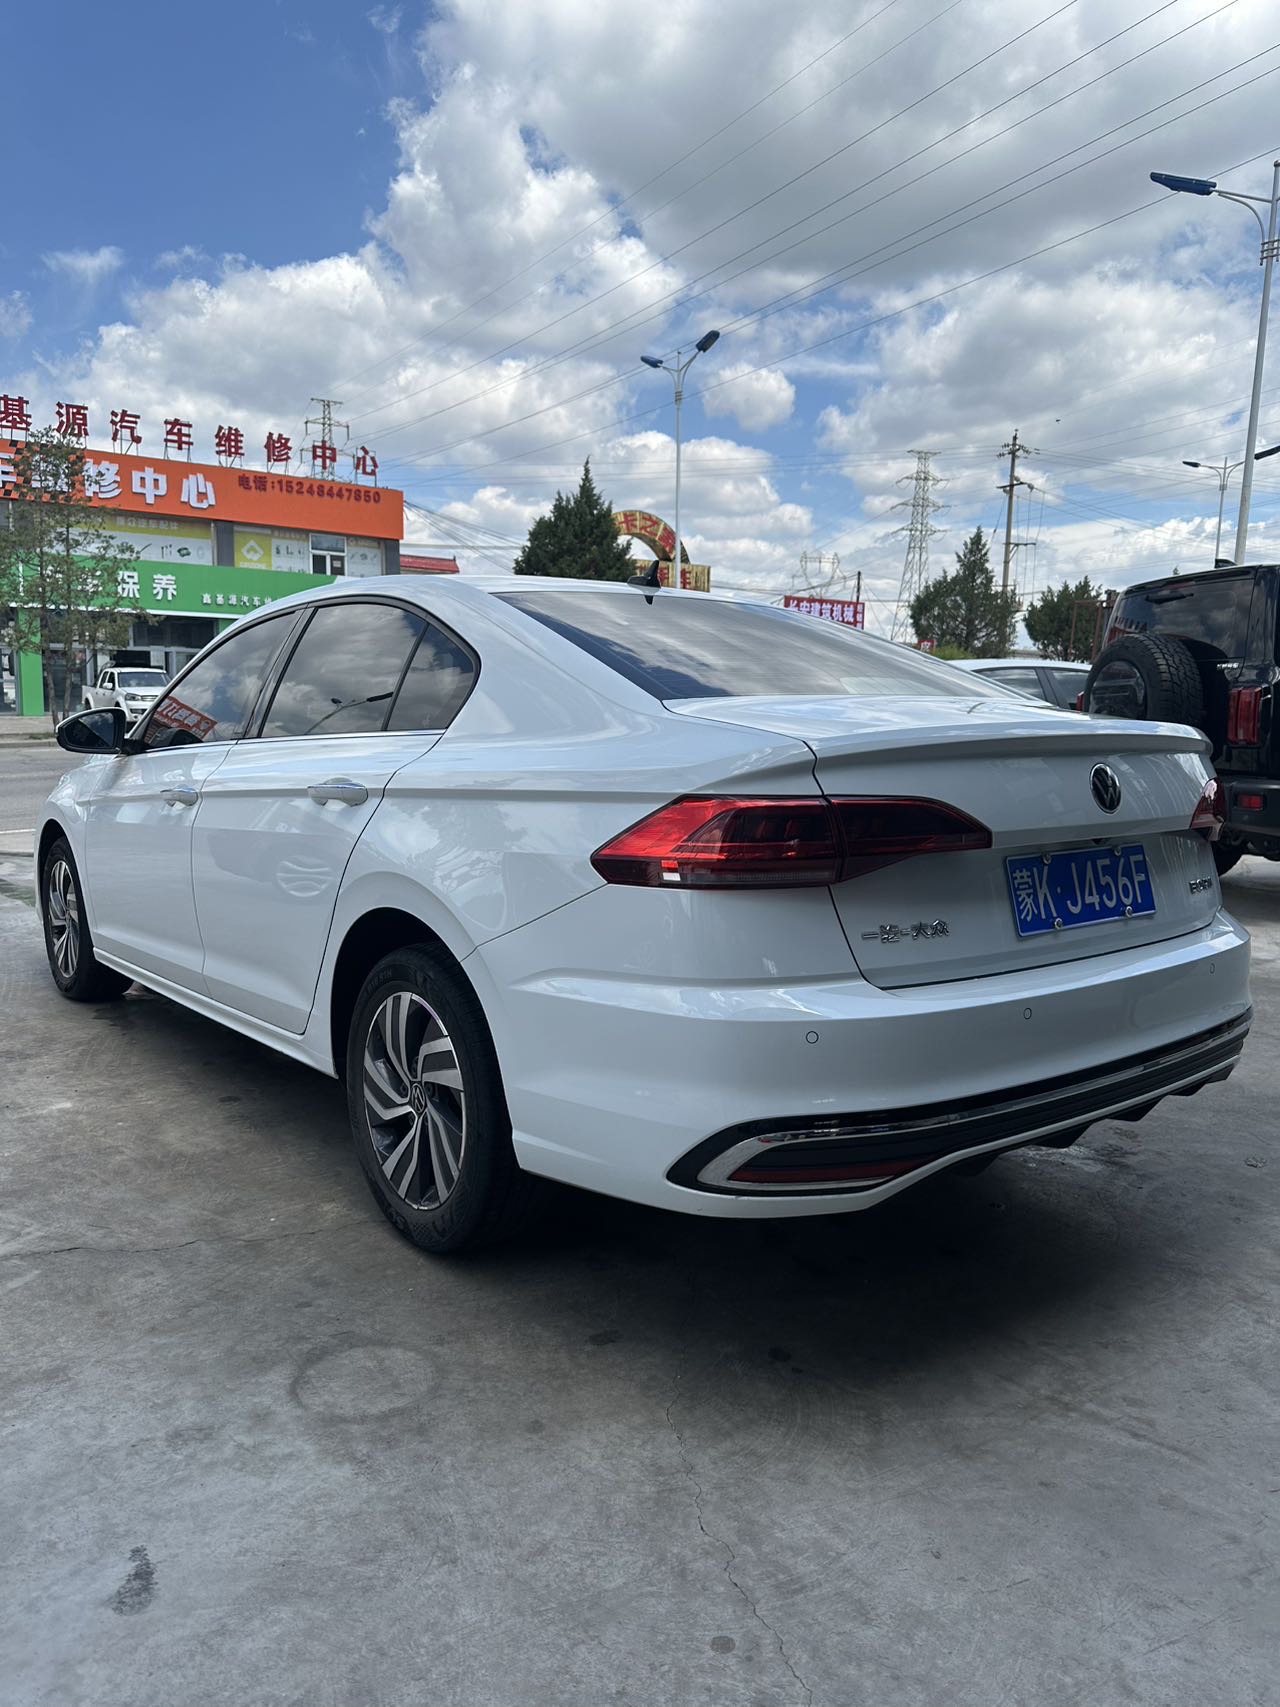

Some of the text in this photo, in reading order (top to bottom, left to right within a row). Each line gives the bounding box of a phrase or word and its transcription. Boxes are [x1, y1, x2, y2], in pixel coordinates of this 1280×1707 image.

[0, 394, 379, 476] 基源汽车维修中心
